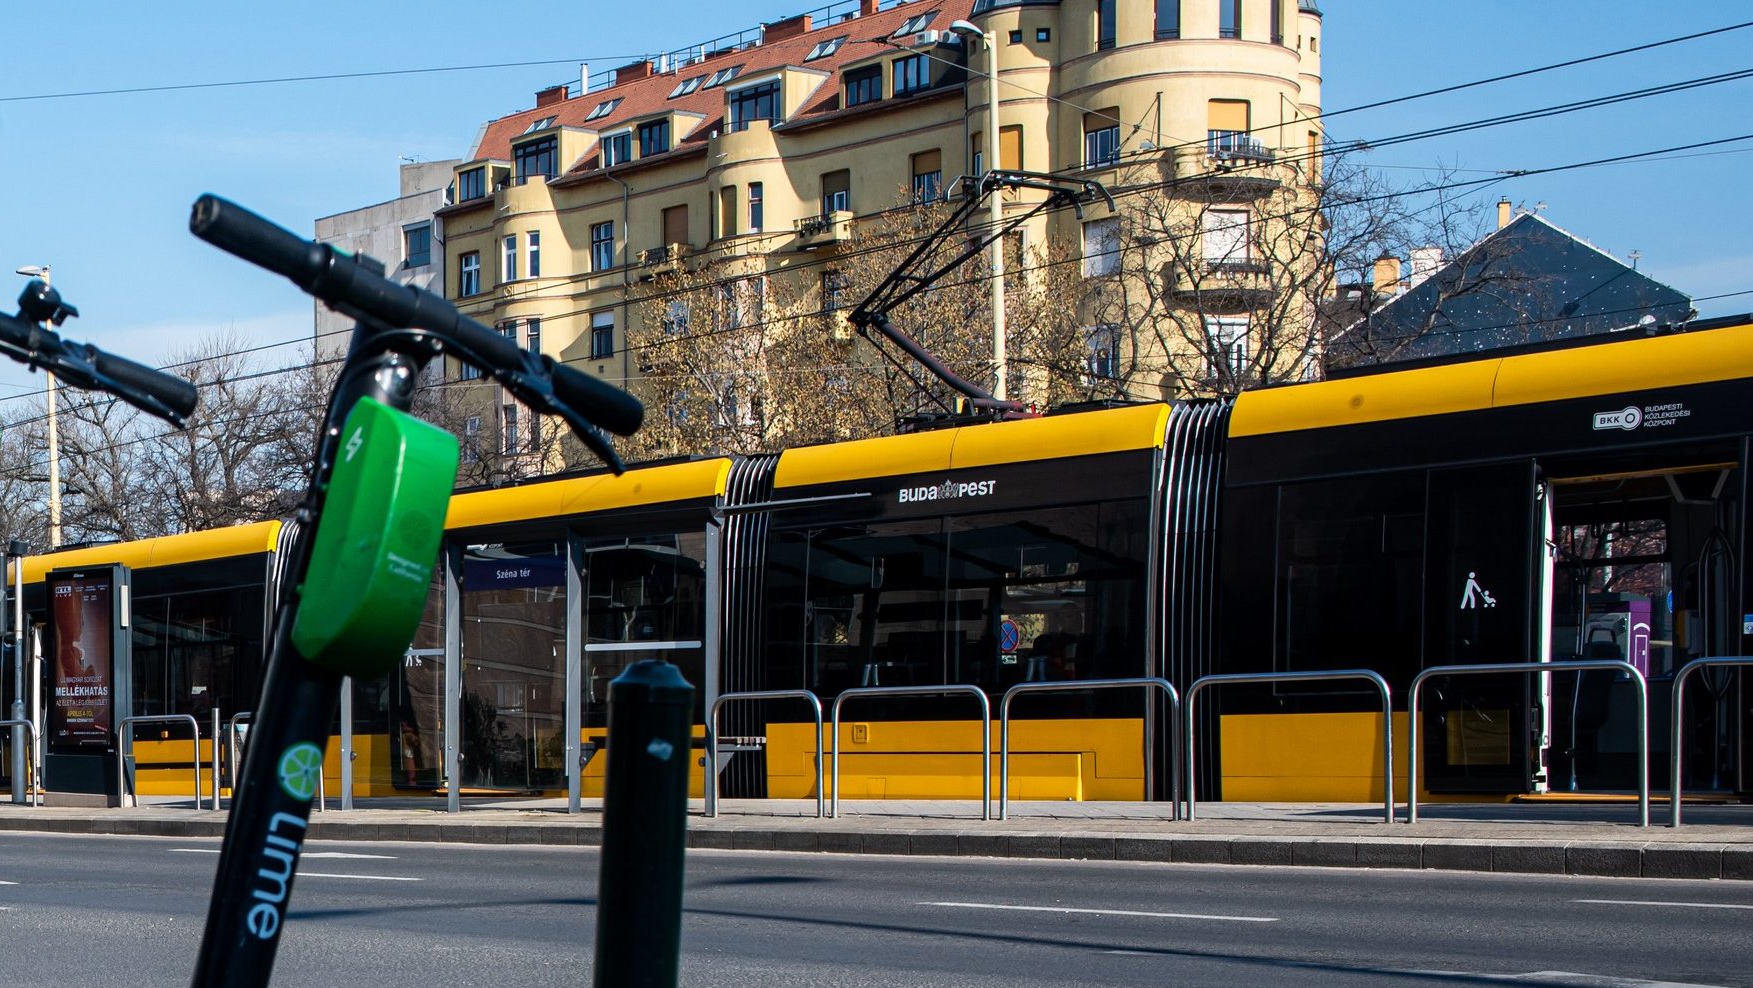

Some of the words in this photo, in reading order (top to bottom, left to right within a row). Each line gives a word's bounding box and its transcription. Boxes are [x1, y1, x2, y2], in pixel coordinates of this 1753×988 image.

[1644, 403, 1683, 413] BUDAPESTI
[1644, 410, 1691, 420] KÖZLEKEDÉSI
[1599, 416, 1620, 425] BKK
[1643, 418, 1676, 427] KÖZPONT
[496, 568, 518, 579] Széna
[520, 567, 531, 578] tér
[55, 684, 109, 697] MELLÉKHATÁS
[247, 810, 308, 941] Lime
